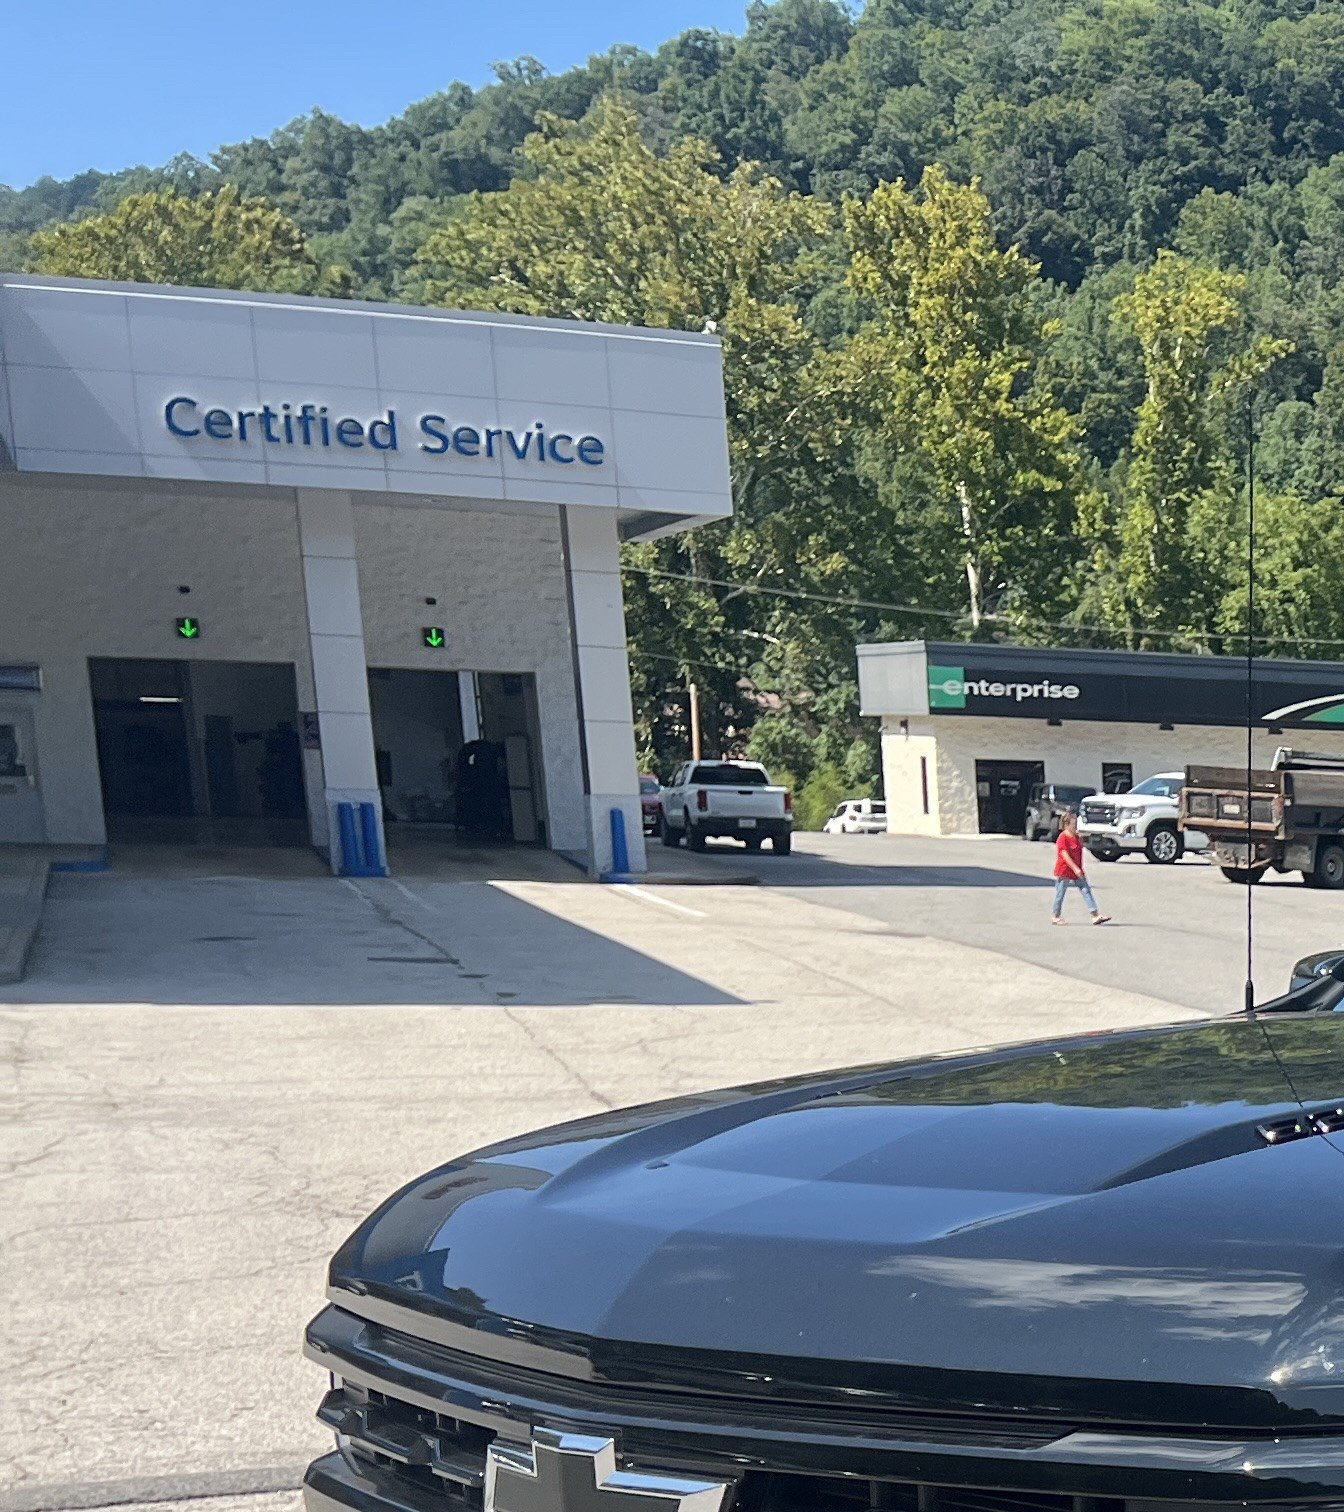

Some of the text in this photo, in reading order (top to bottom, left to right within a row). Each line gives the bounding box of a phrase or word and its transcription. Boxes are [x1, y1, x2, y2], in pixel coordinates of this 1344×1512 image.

[164, 397, 605, 466] Certified Service
[945, 680, 1080, 702] enterprise
